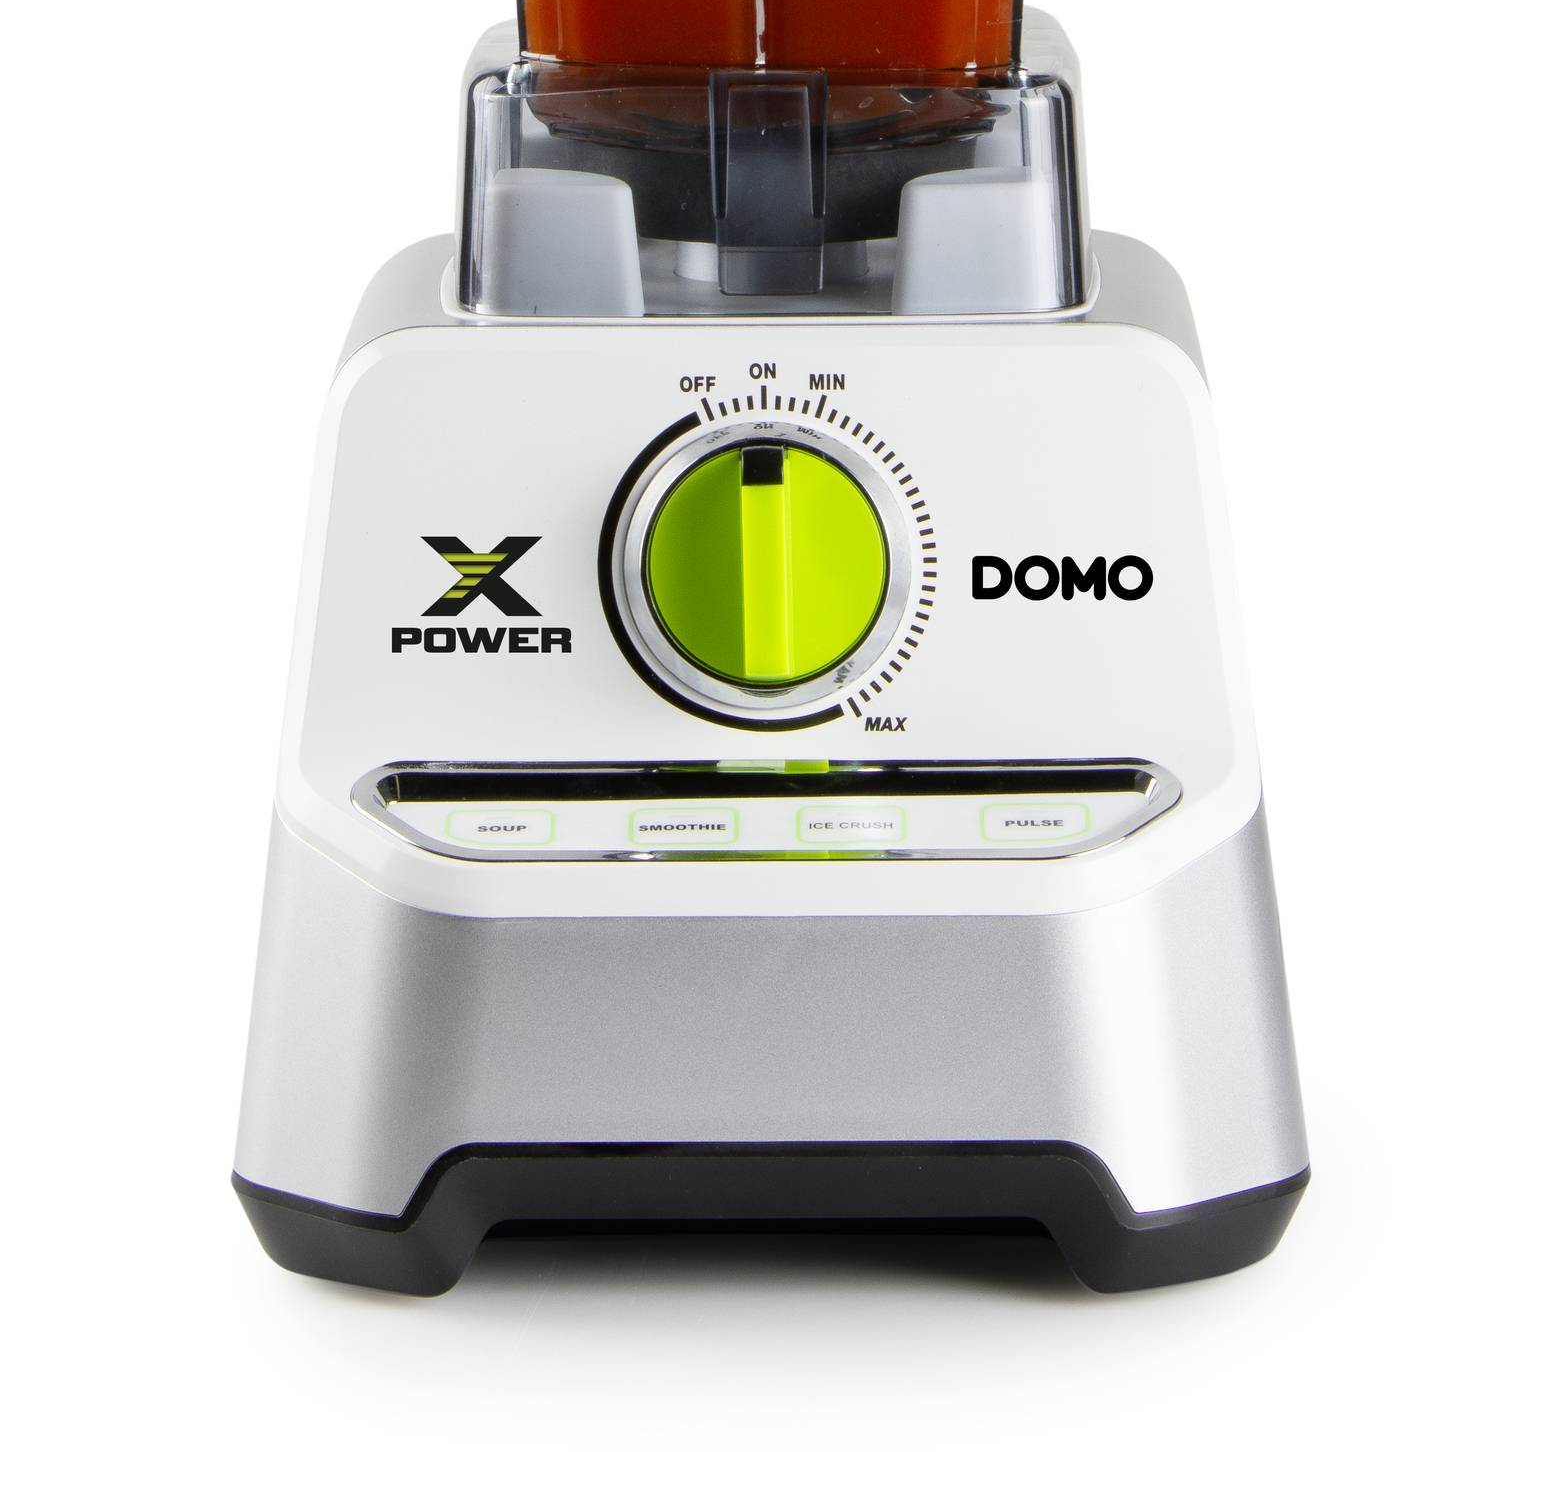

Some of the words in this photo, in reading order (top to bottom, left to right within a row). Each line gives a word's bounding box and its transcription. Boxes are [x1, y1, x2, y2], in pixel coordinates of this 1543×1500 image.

[749, 363, 776, 380] ON
[679, 376, 716, 393] OFF
[809, 373, 845, 390] MIN
[972, 555, 1154, 601] DOMO
[391, 627, 572, 654] POWER
[864, 717, 907, 732] MAX
[477, 825, 527, 833] SOUP
[638, 823, 727, 832] SMOOTHIE
[808, 822, 834, 830] ICE
[838, 821, 894, 830] CRUSH
[1004, 819, 1064, 828] PULSE
